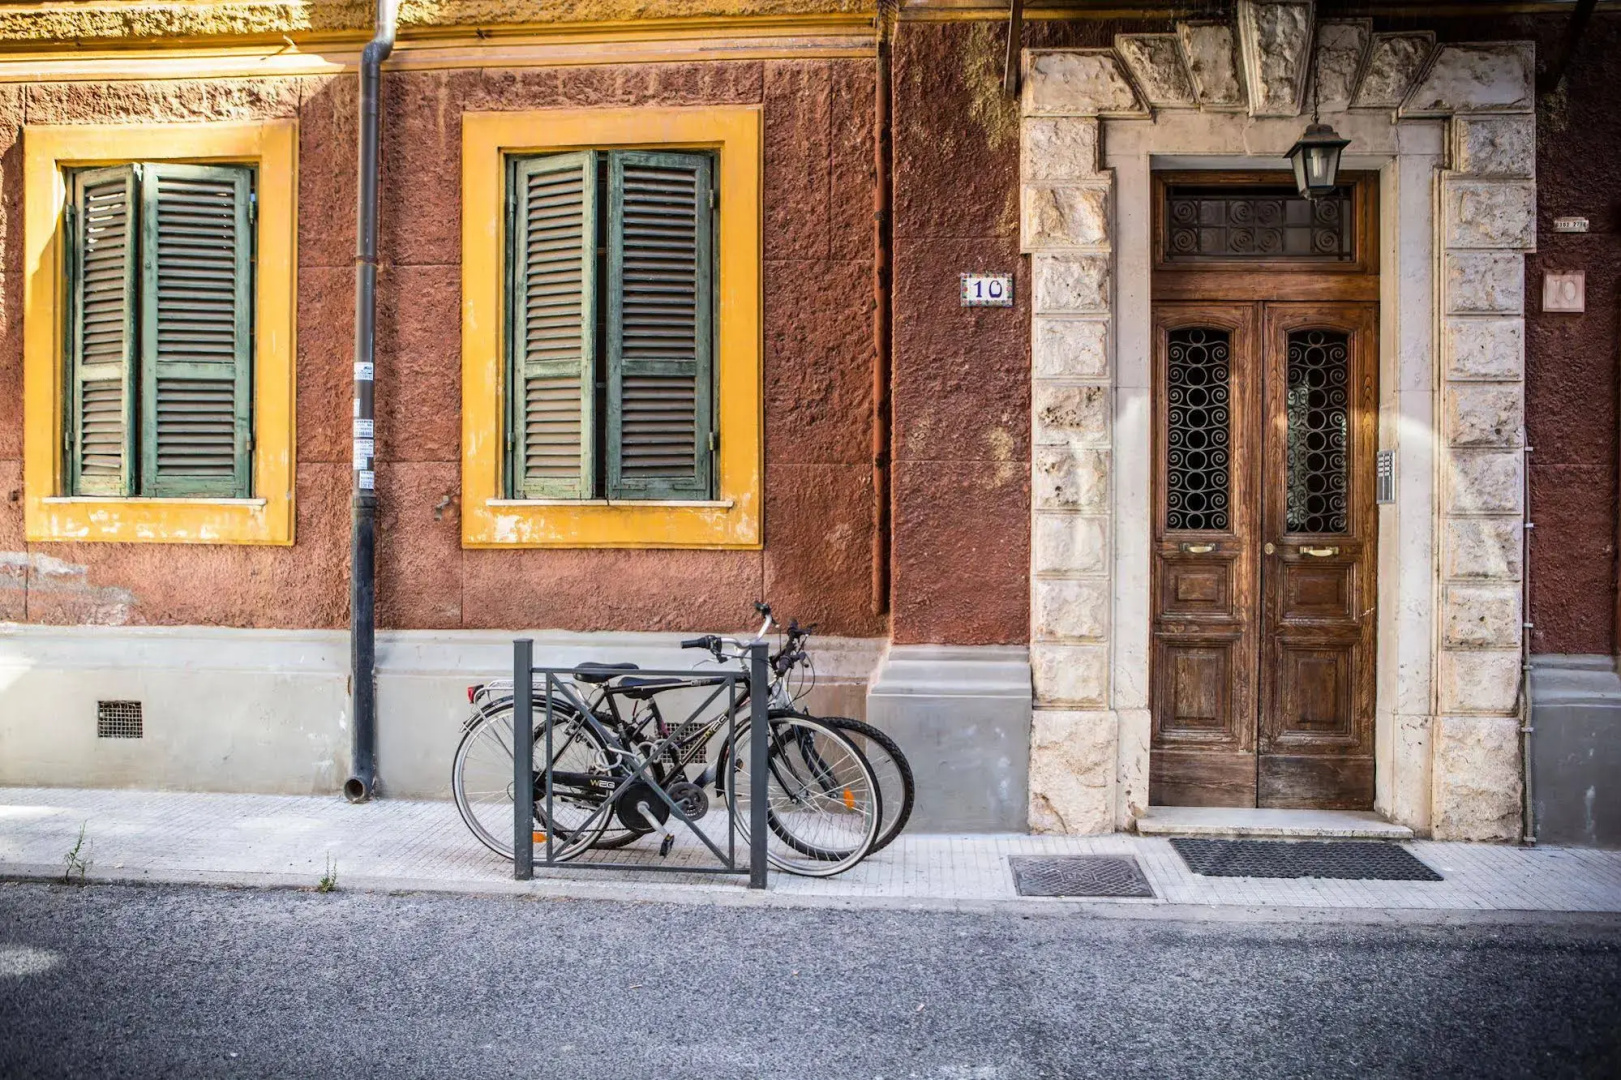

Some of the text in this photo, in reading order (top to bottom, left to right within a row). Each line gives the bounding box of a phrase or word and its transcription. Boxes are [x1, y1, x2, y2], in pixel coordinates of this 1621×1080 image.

[973, 280, 1003, 299] 10
[1551, 279, 1577, 303] 10
[590, 779, 616, 789] WEG
